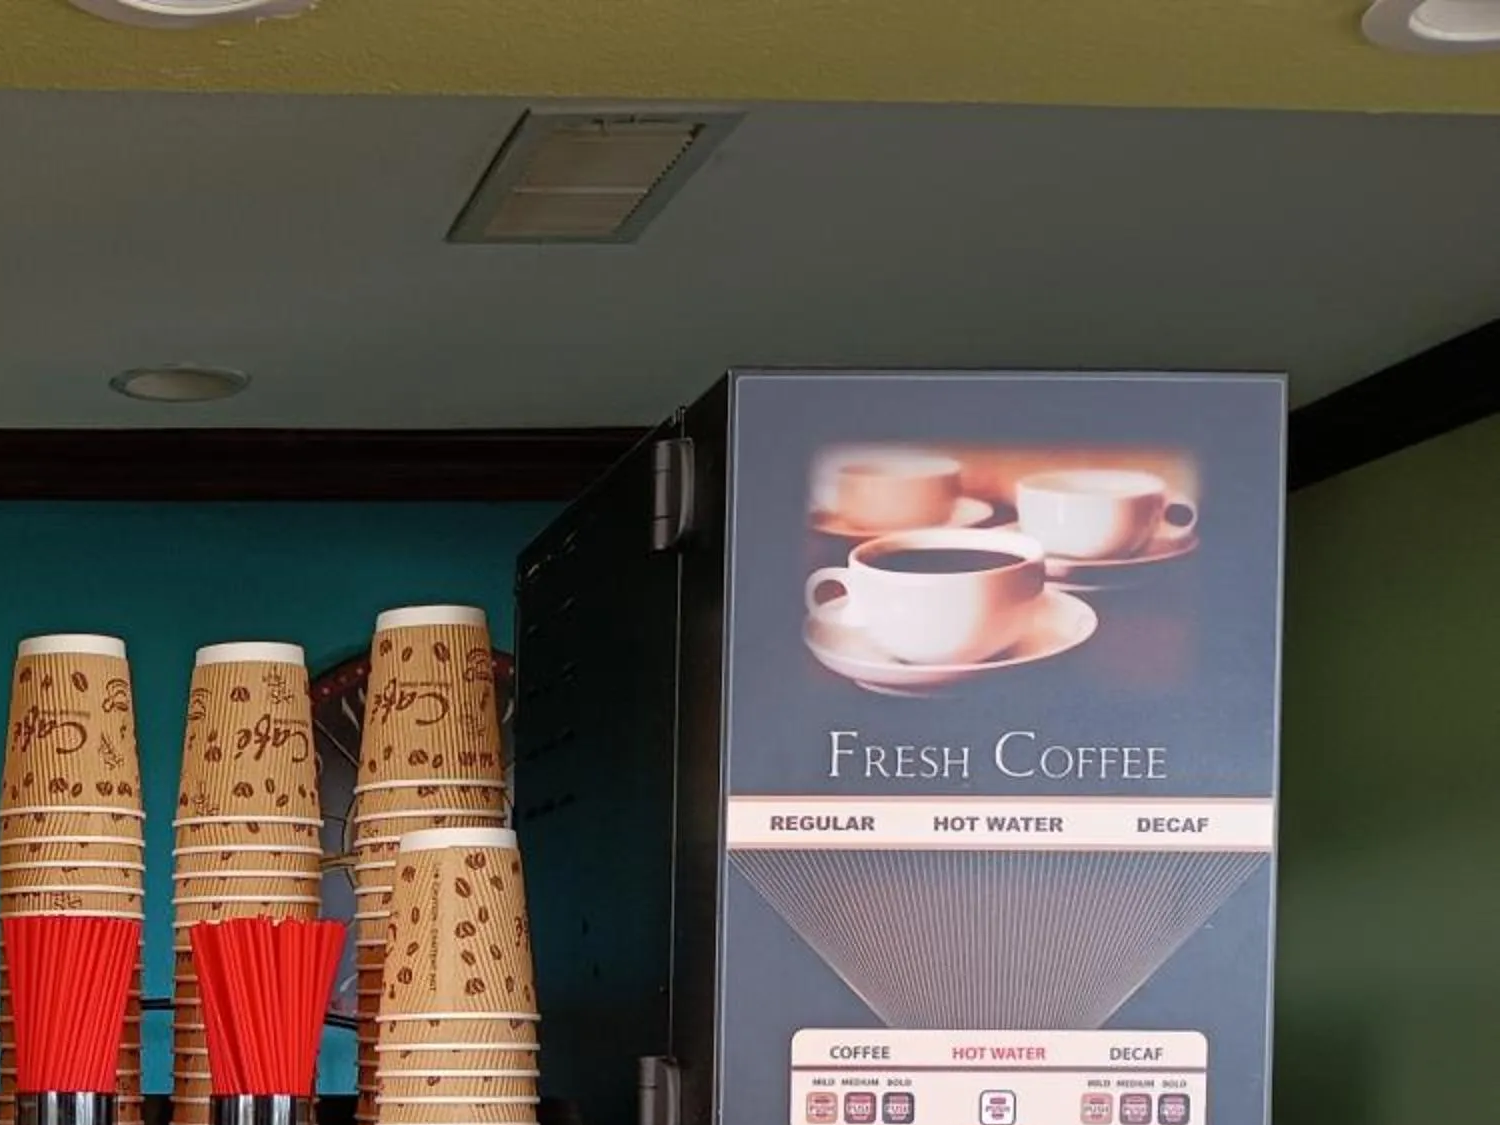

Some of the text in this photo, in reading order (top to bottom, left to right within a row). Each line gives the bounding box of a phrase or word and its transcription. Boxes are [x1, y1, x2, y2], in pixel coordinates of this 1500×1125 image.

[827, 730, 1168, 780] FRESH COFFEE
[770, 815, 876, 833] REGULAR
[933, 815, 1064, 834] HOT WATER
[1137, 816, 1210, 834] DECAF
[829, 1045, 891, 1060] COFFEE
[952, 1046, 1047, 1061] HOT WATER
[1109, 1046, 1164, 1062] DECAF
